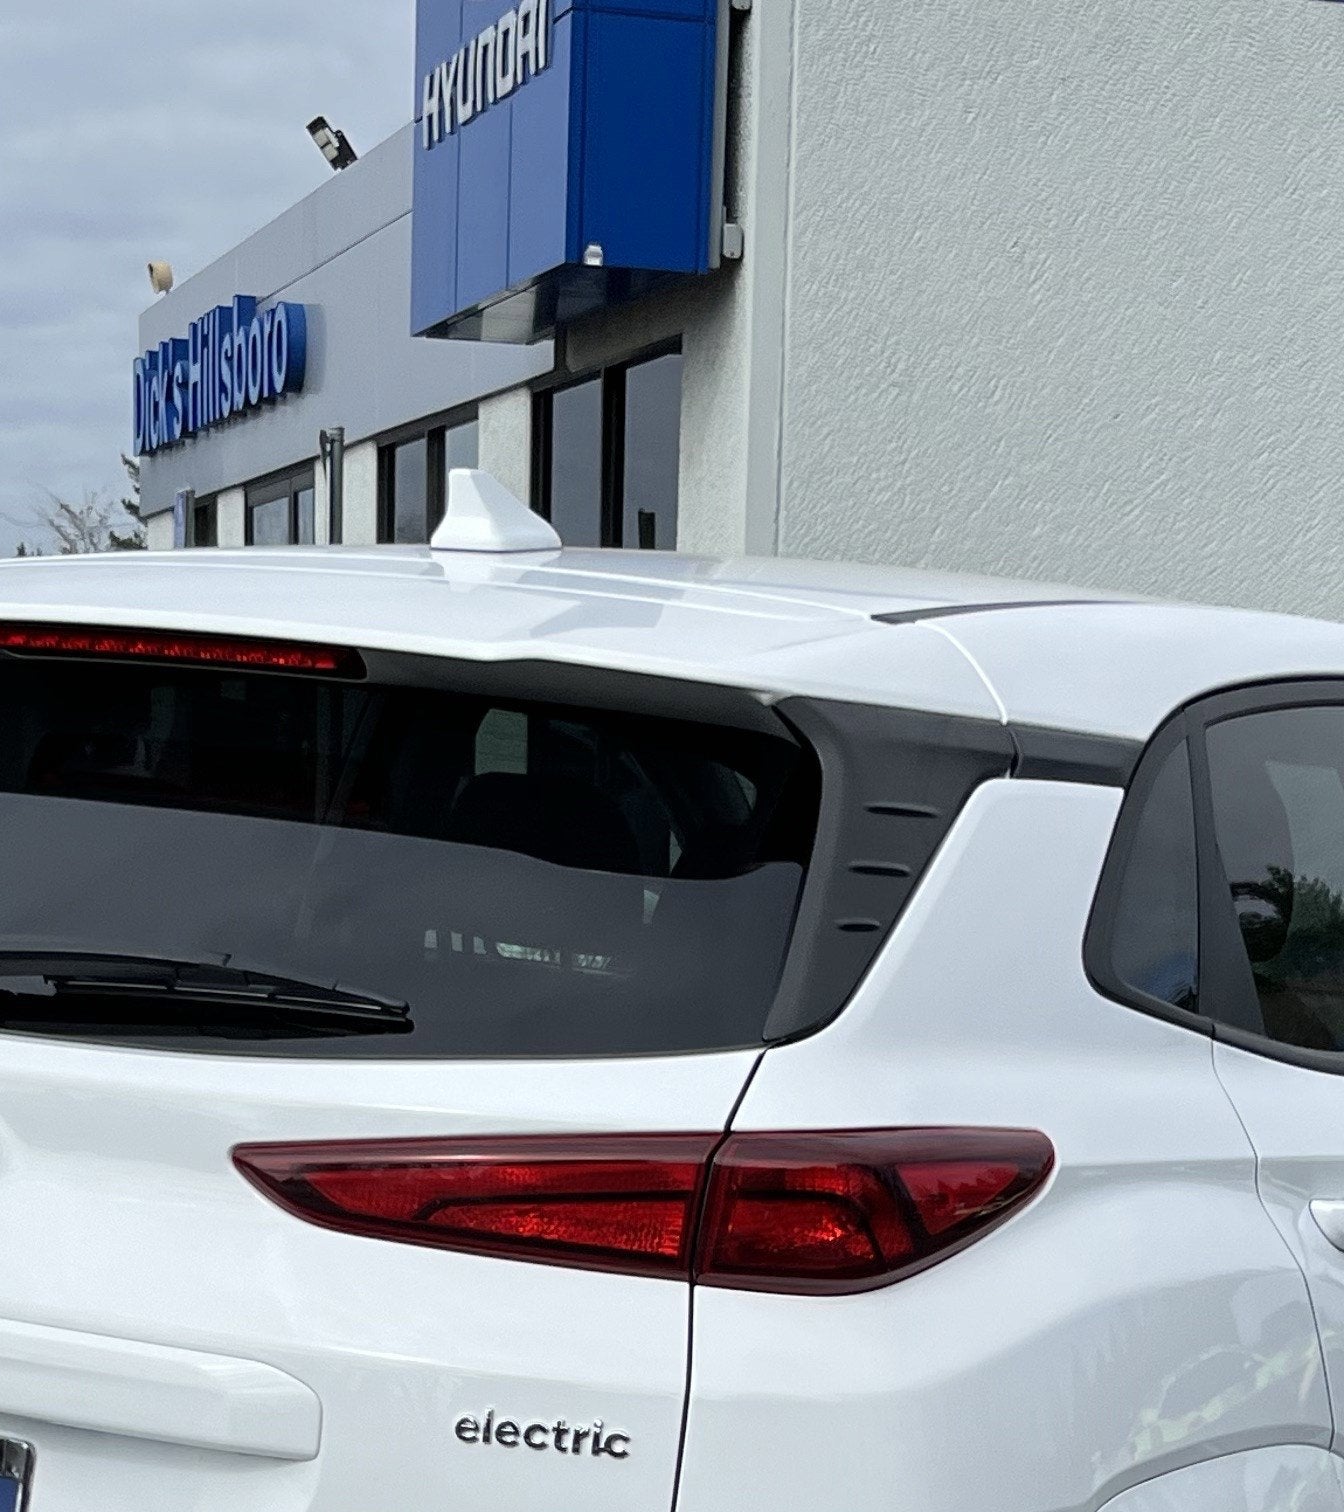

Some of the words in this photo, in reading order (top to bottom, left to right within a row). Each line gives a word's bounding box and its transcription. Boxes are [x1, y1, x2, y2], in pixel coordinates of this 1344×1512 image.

[423, 0, 548, 150] HYUNDAI
[133, 337, 183, 456] Dick's
[188, 294, 288, 432] Hillsboro
[454, 1406, 631, 1459] electric
